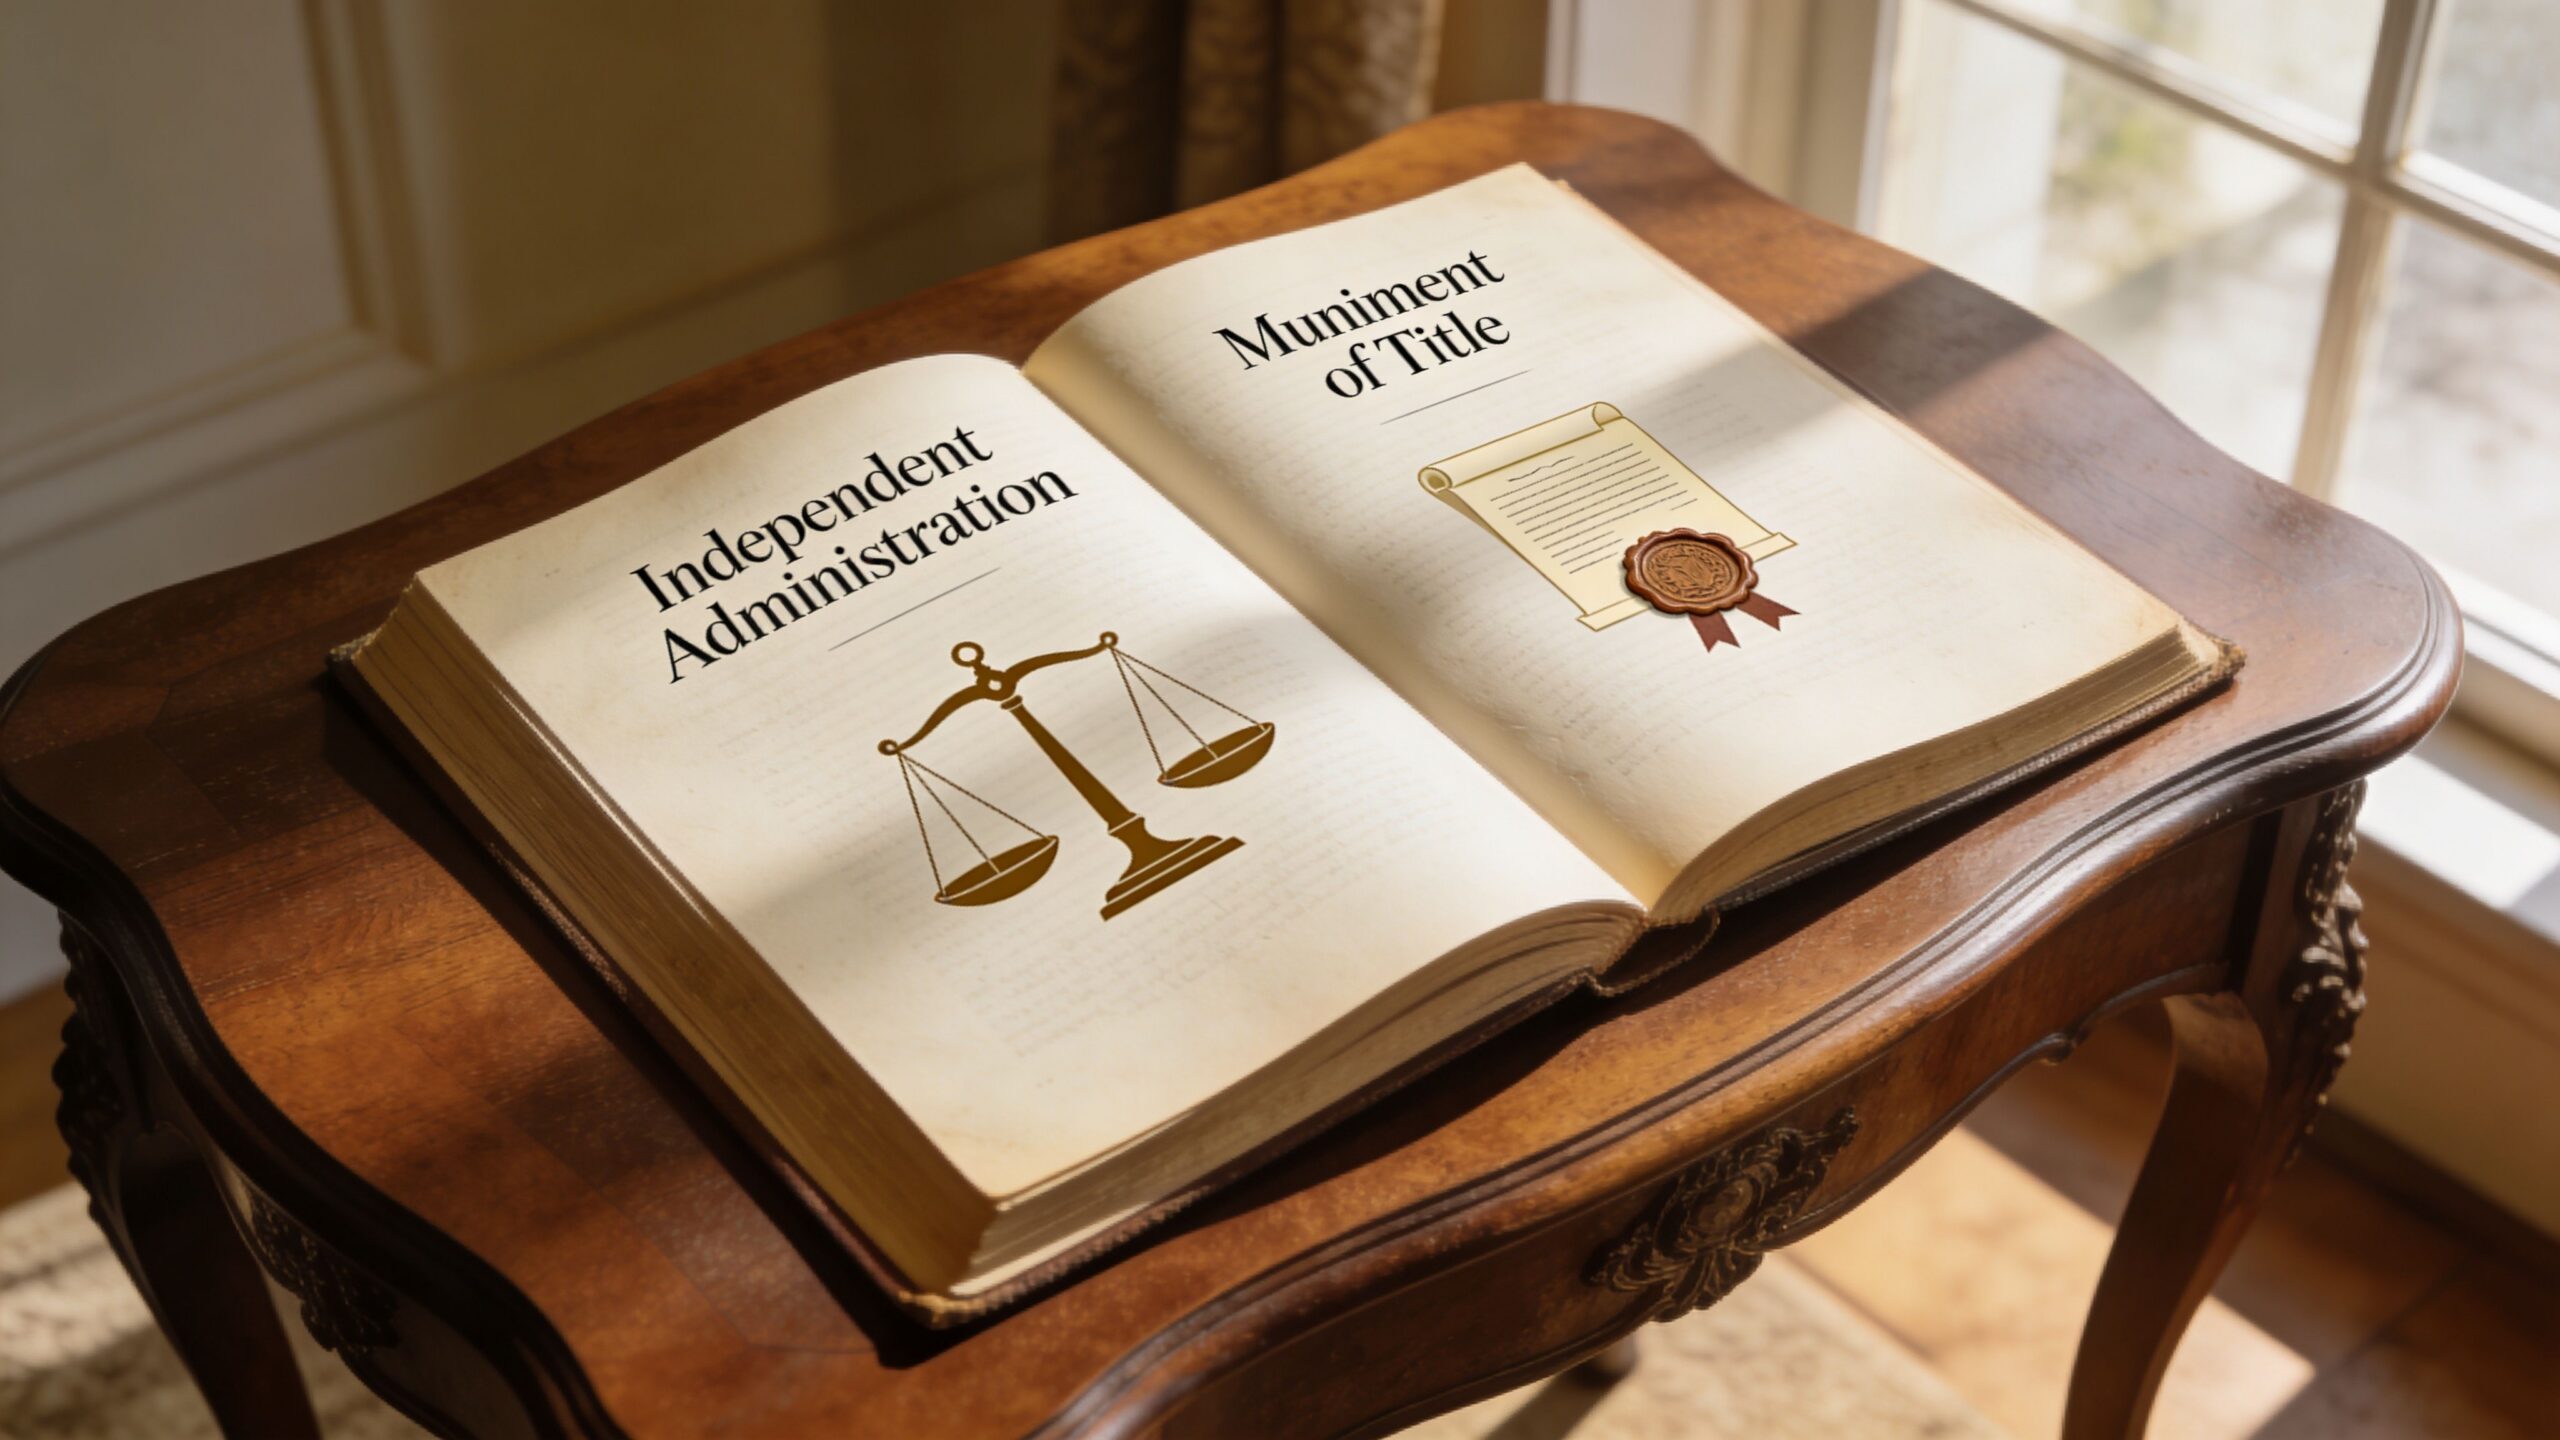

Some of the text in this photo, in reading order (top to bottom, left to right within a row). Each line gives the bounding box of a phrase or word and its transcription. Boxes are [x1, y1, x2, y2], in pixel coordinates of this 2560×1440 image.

[1212, 250, 1505, 370] Muniment
[1325, 310, 1510, 398] of Title
[630, 426, 994, 613] Independent
[664, 470, 1079, 684] Administration
